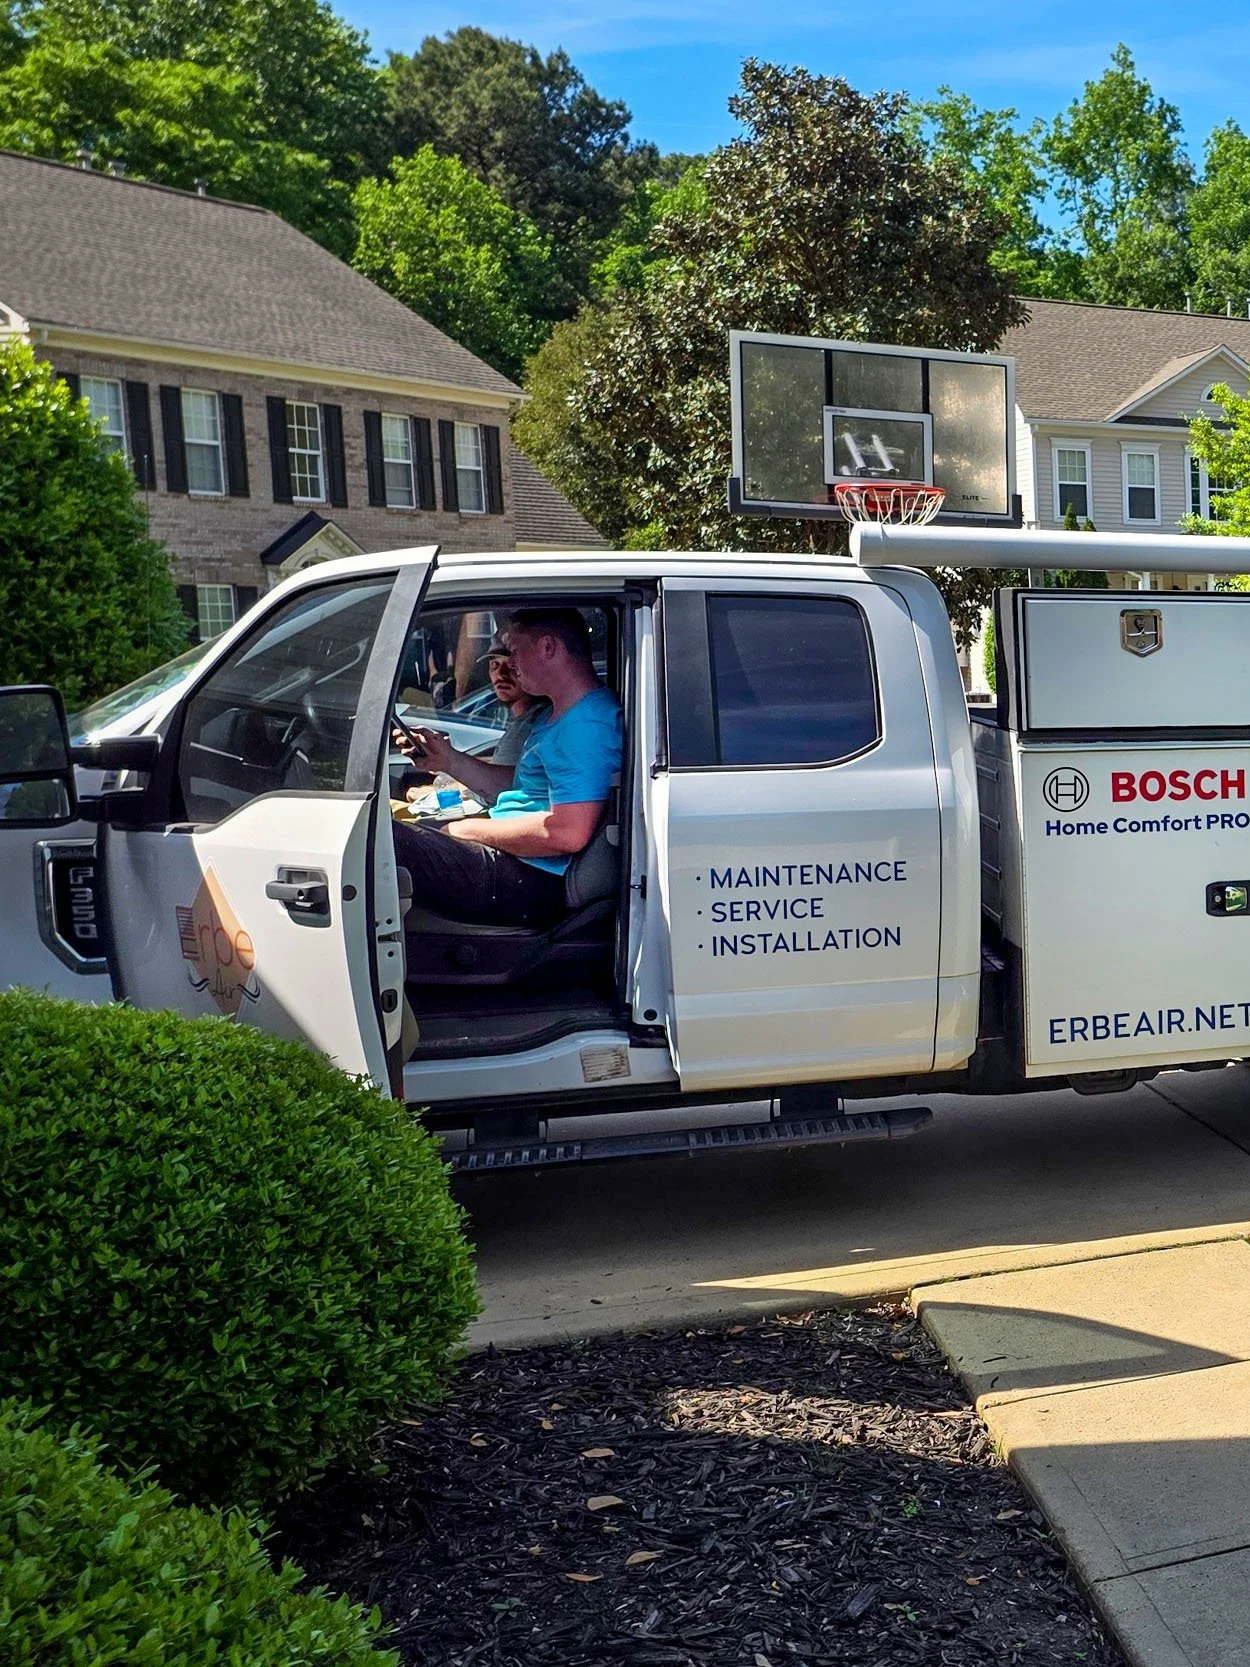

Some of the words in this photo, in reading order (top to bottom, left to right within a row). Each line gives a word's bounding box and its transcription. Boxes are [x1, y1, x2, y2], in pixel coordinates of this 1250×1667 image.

[1111, 769, 1246, 802] BOSCH
[1046, 819, 1108, 837] Home
[1112, 814, 1202, 834] Comfort
[1206, 812, 1250, 830] PRO
[710, 860, 907, 889] MAINTENANCE
[69, 866, 98, 939] F350
[711, 897, 824, 923] SERVICE
[712, 926, 901, 957] INSTALLATION
